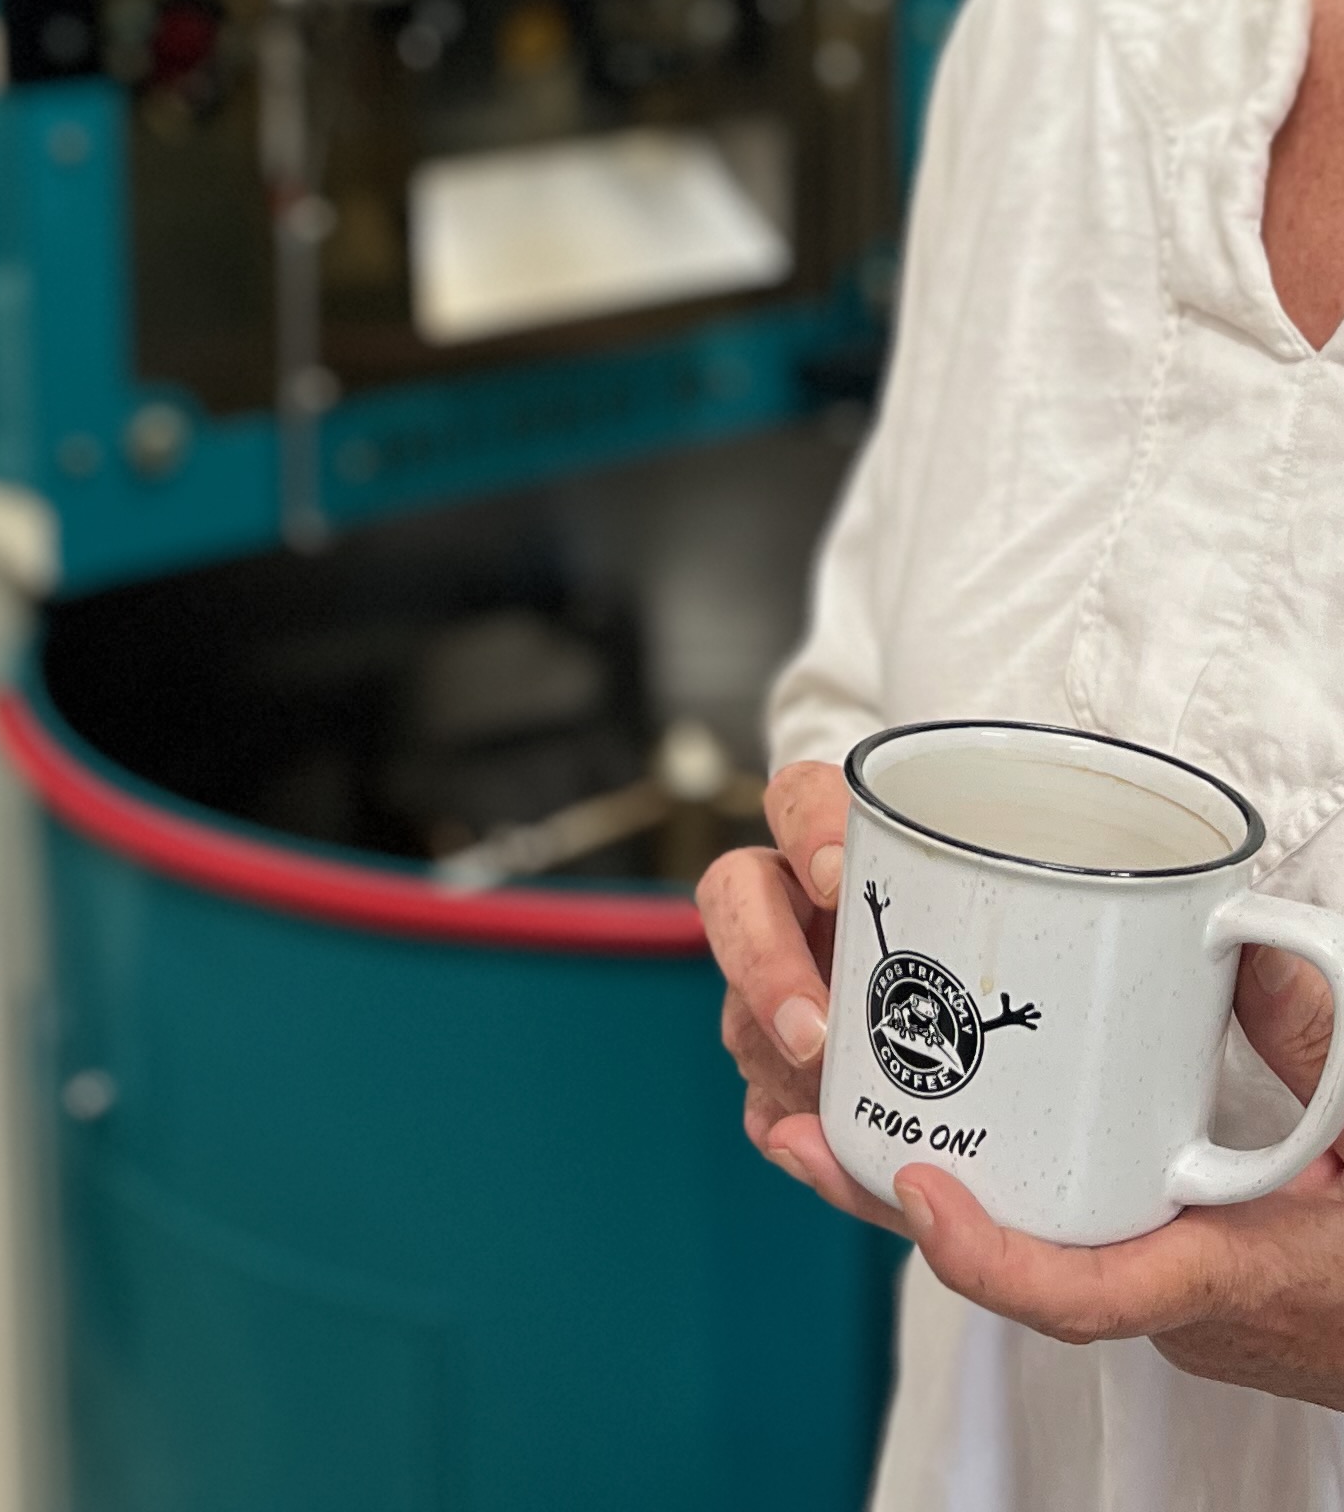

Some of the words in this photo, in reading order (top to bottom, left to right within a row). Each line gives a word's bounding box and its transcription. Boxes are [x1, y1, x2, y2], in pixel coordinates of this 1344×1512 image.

[875, 963, 904, 998] FROG
[908, 961, 974, 1035] FRIENDLY
[880, 1045, 952, 1091] COFFEE
[854, 1095, 923, 1144] FROG
[929, 1124, 987, 1158] ON!
